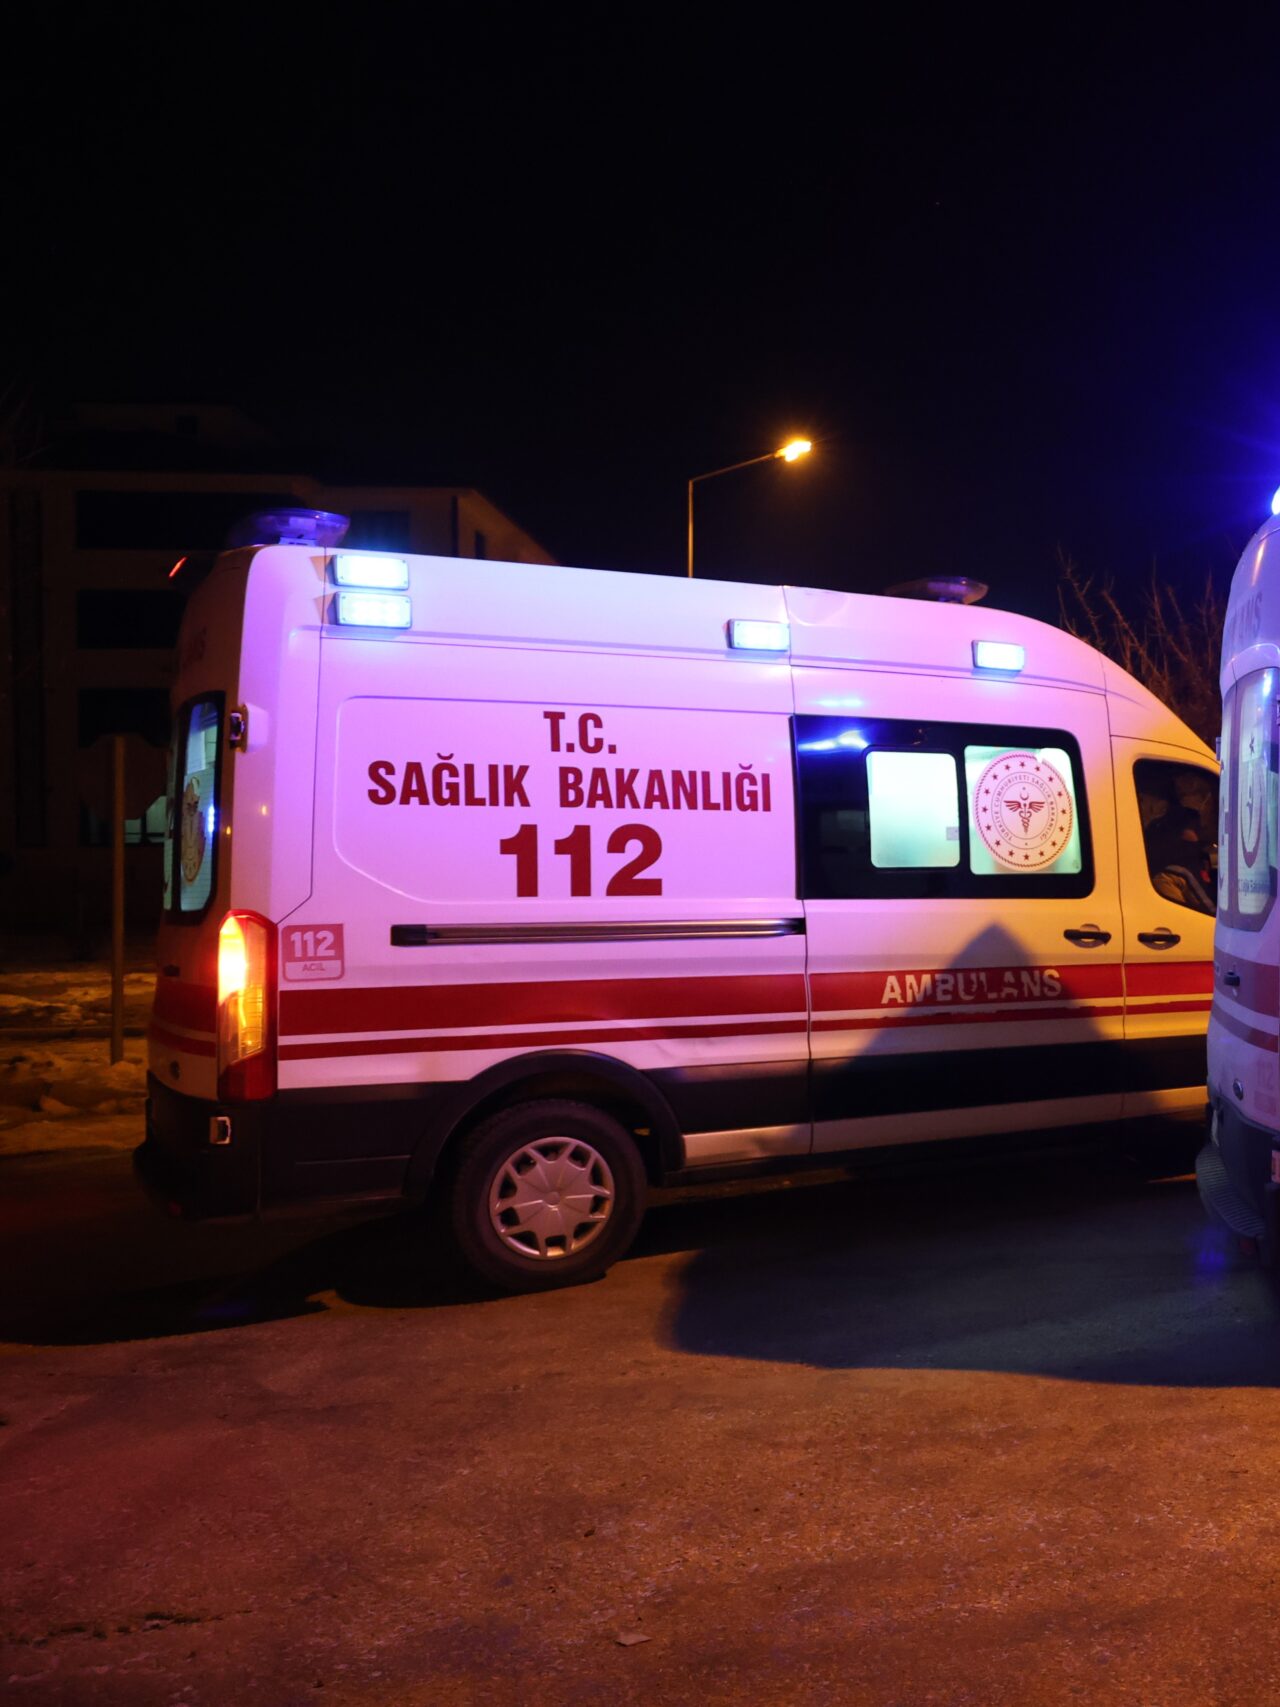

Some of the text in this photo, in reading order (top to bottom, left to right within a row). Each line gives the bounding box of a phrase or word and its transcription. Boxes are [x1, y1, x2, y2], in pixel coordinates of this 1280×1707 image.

[543, 711, 617, 755] T.C.
[368, 752, 771, 813] SAĞLIK BAKANLIĞI
[500, 823, 663, 897] 112
[290, 930, 336, 958] 112
[881, 968, 1062, 1004] AMBULANS
